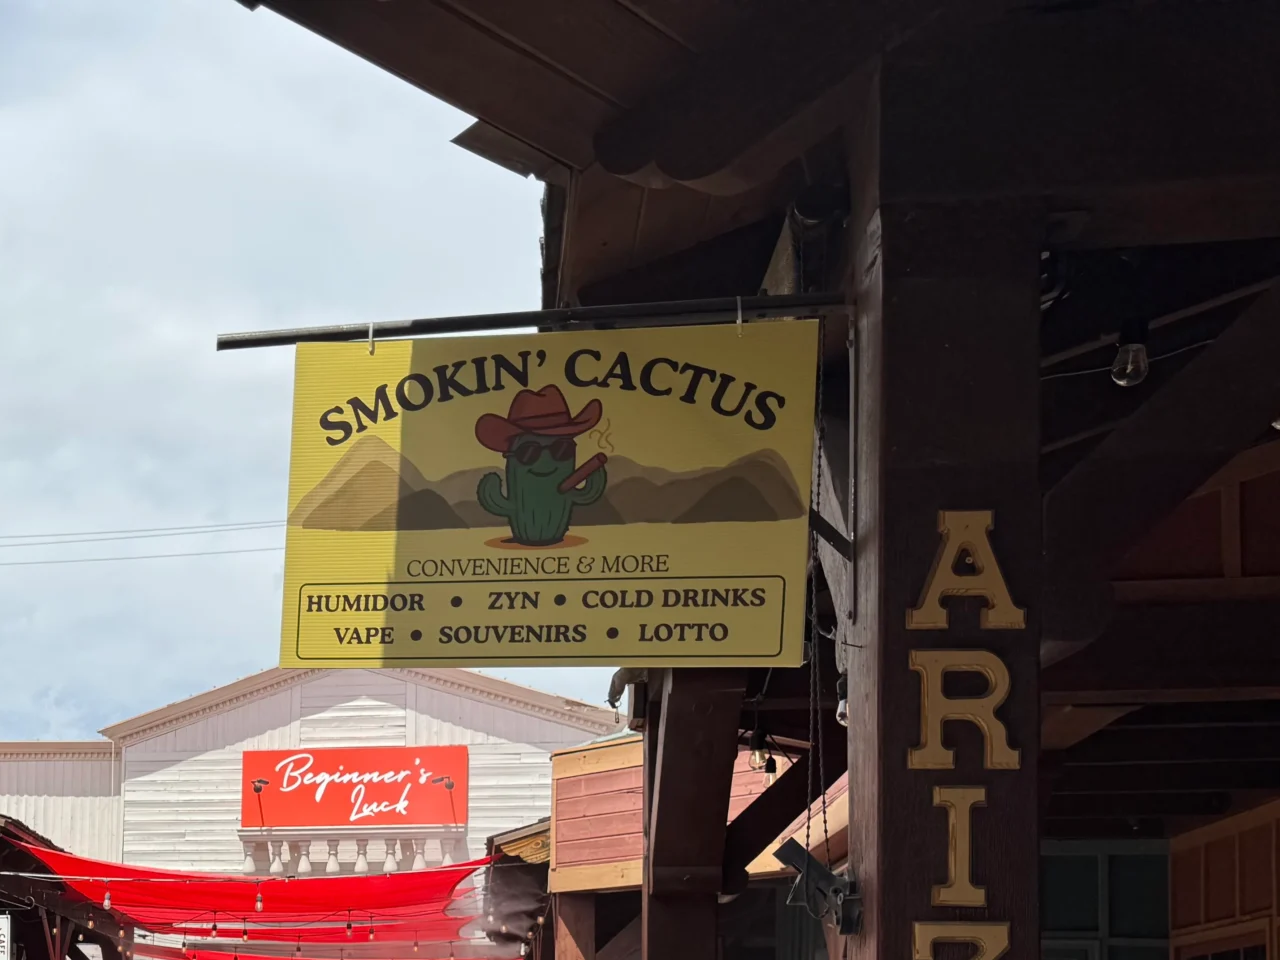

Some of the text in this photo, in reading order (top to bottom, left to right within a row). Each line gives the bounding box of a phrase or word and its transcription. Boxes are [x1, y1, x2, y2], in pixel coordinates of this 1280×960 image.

[320, 348, 786, 447] SMOKIN' CACTUS
[406, 553, 670, 578] CONVENIENCE & MORE
[306, 587, 766, 613] HUMIDOR ZYN COLD DRINKS
[334, 622, 729, 646] VAPE SOUVENIRS LOTTO
[274, 753, 433, 803] Beginner's
[349, 783, 412, 821] Luck
